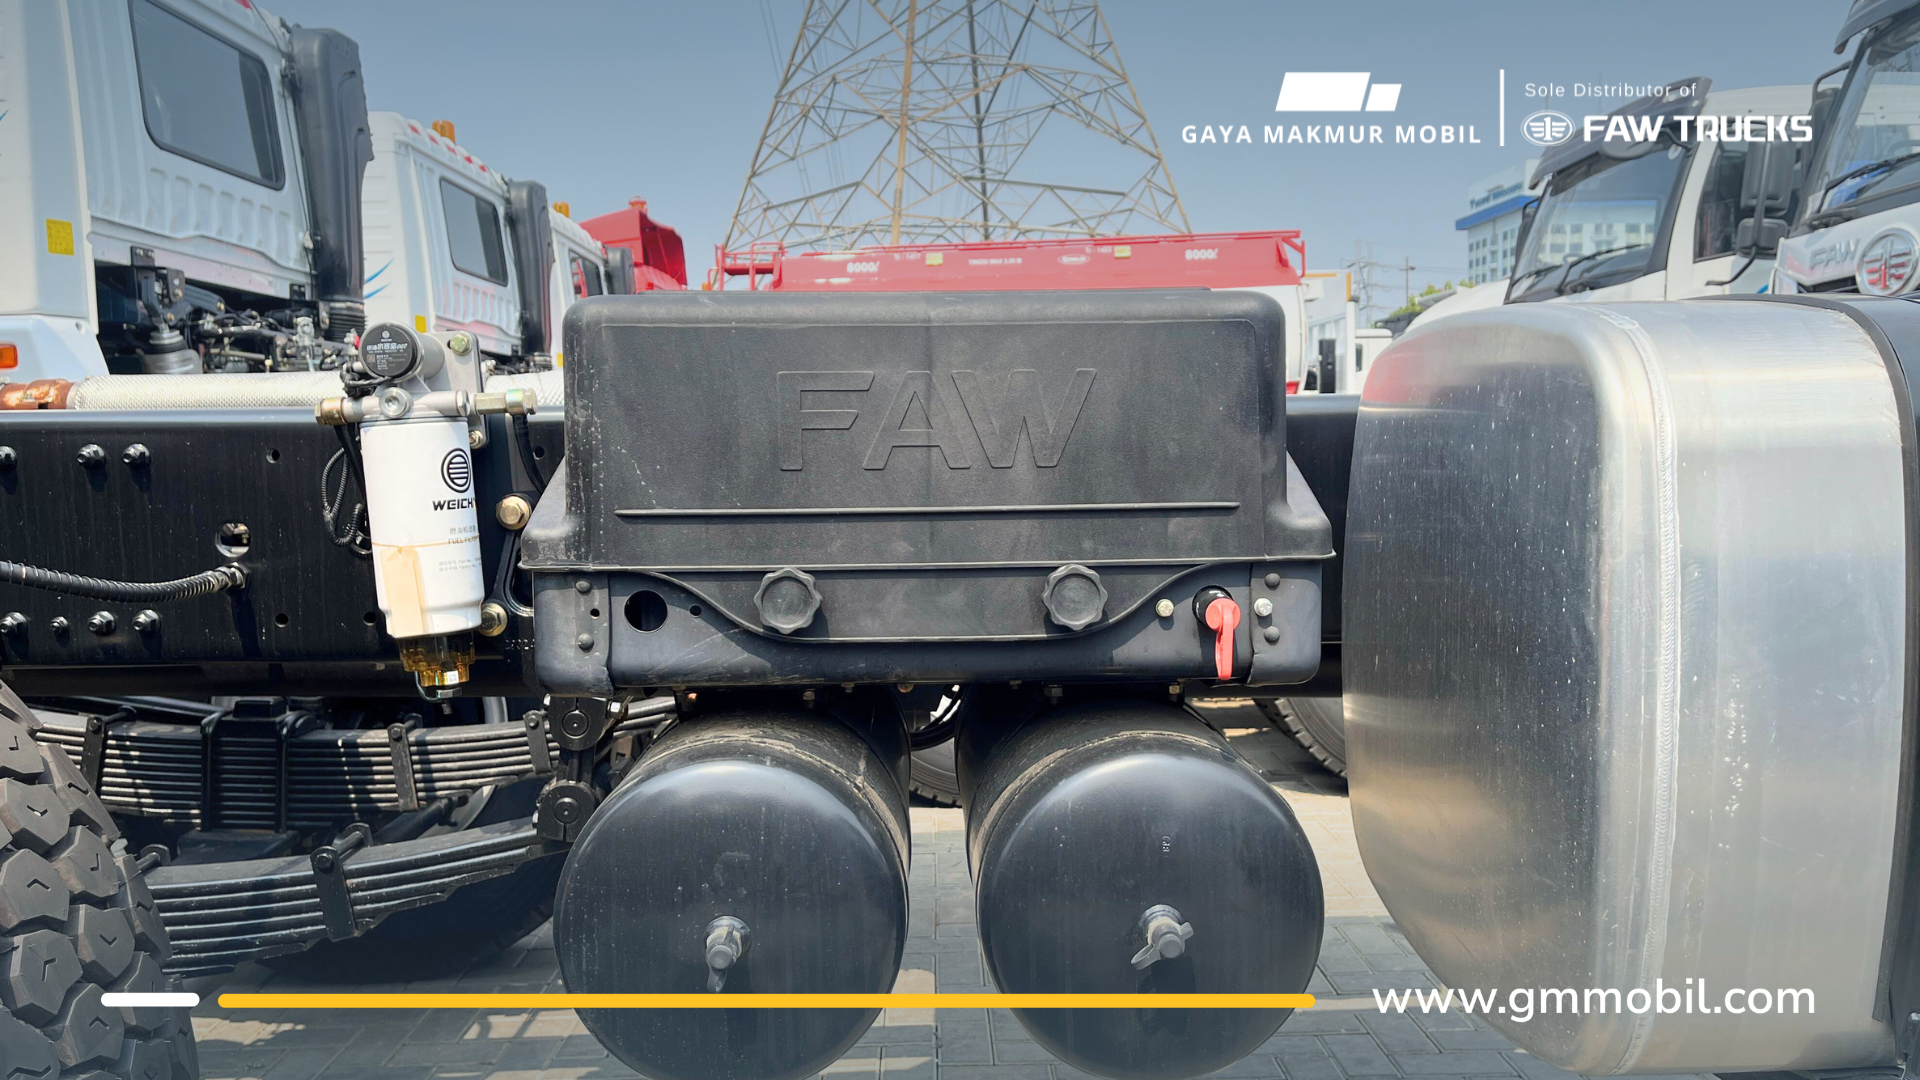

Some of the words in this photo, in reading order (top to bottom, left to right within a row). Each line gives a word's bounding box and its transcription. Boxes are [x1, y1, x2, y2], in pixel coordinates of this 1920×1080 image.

[1811, 237, 1861, 270] FAW
[777, 368, 1097, 471] FAW
[432, 497, 475, 511] WEICH
